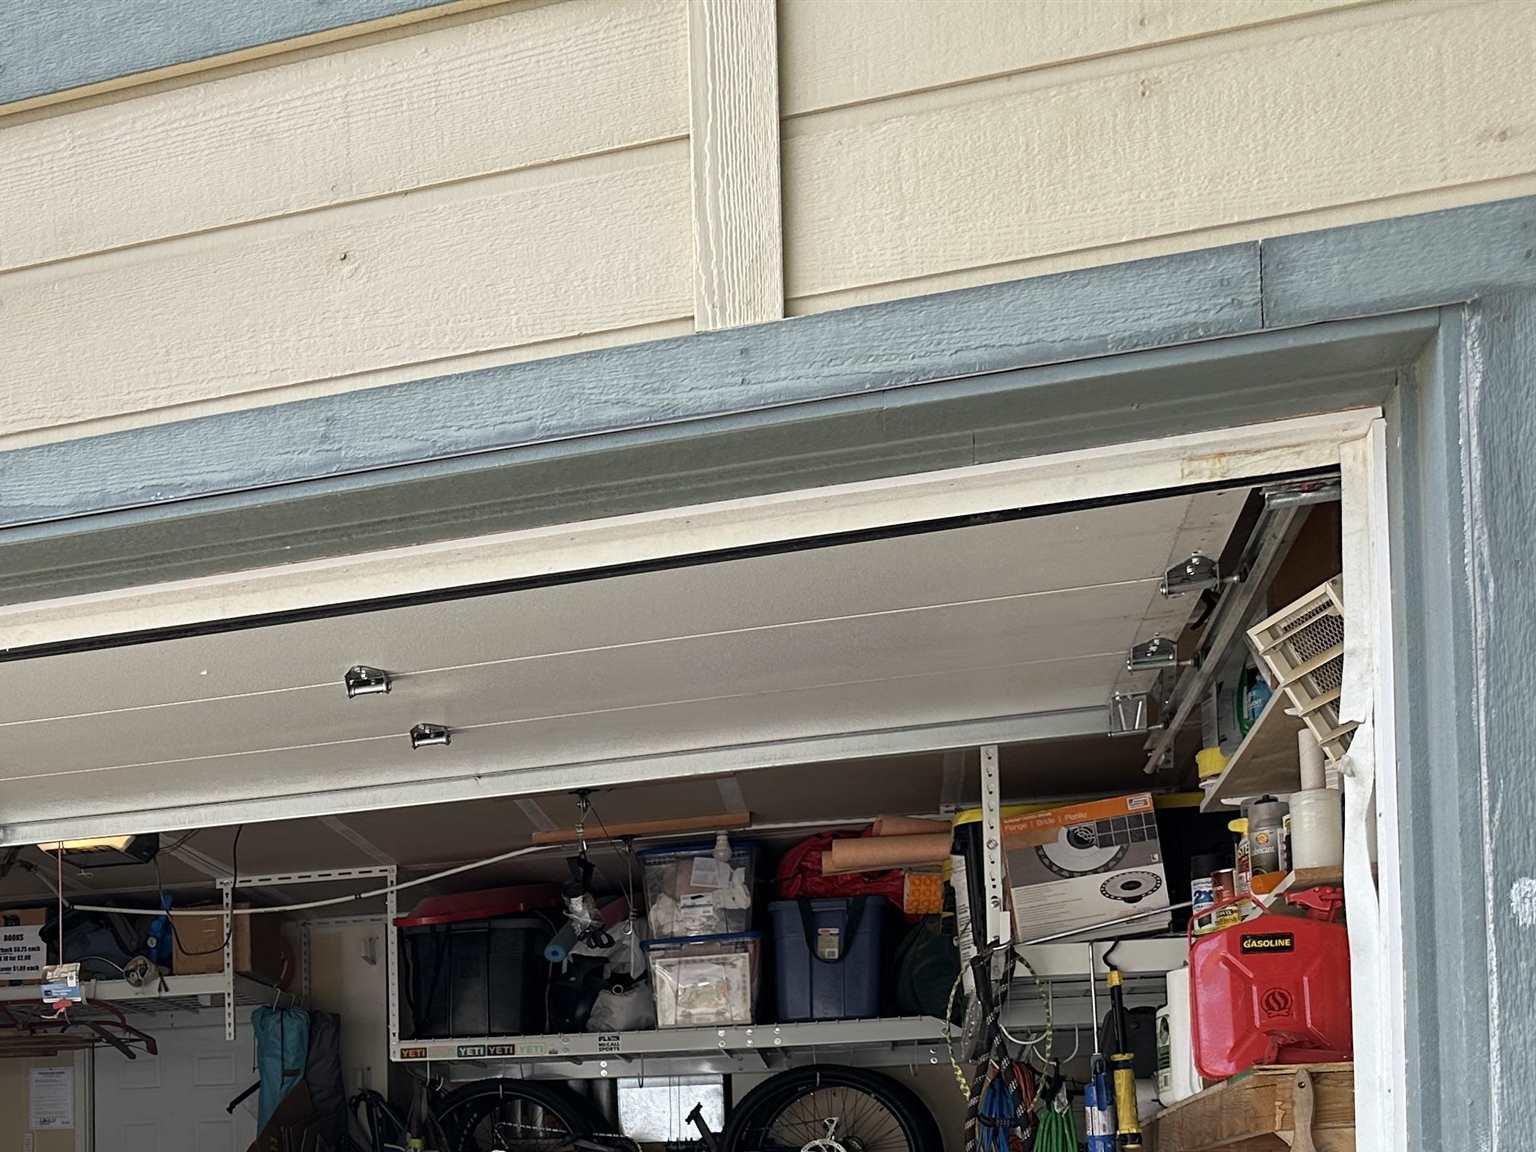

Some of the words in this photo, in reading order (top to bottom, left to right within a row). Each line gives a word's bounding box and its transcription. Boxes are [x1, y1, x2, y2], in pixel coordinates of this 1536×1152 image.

[1243, 938, 1291, 949] GASOLINE
[401, 1049, 425, 1058] YETI
[459, 1046, 485, 1056] YETI
[488, 1045, 514, 1055] YETI
